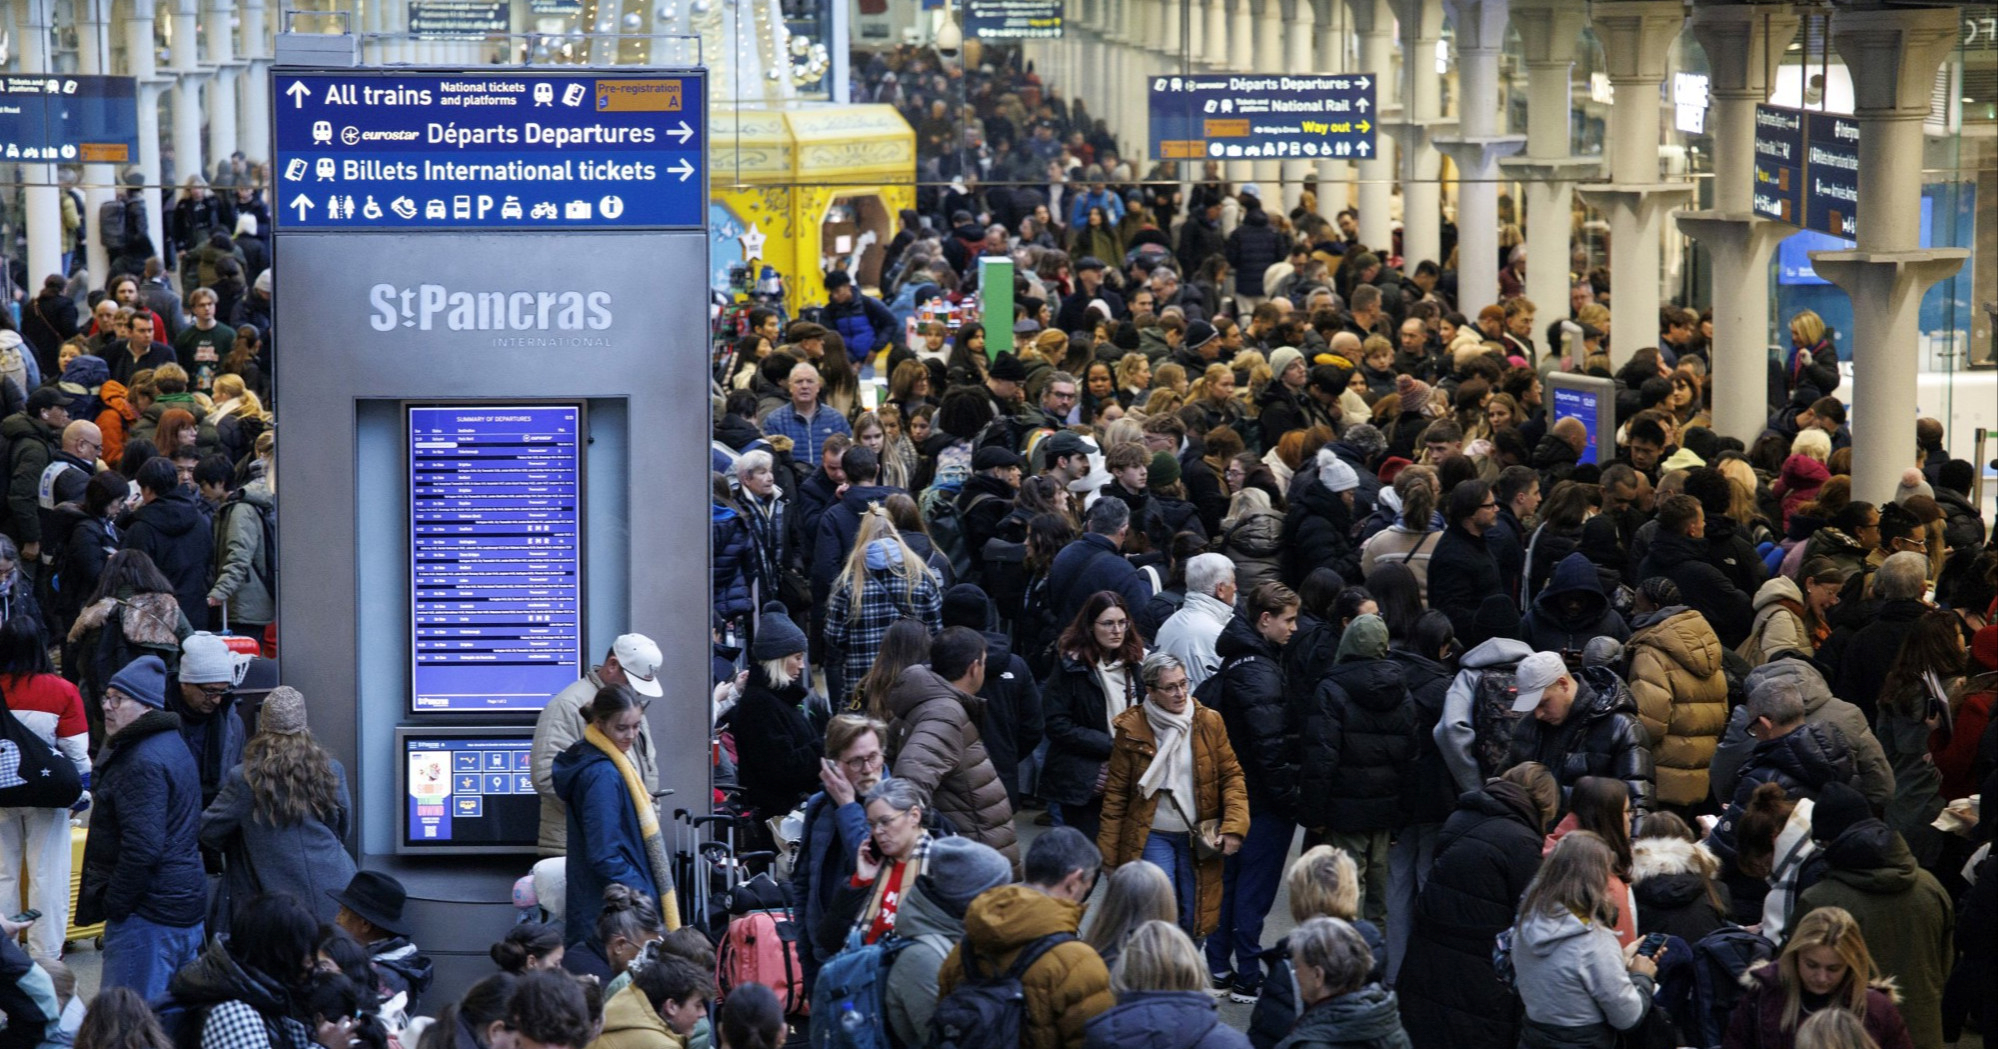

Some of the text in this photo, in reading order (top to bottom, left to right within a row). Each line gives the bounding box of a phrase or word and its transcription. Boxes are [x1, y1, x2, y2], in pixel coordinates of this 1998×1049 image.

[440, 82, 526, 92] National tickets
[598, 83, 680, 95] Pre-registration
[1229, 78, 1278, 92] Départs
[1280, 78, 1350, 92] Departures
[325, 84, 432, 105] All trains
[440, 95, 517, 107] and platforms
[668, 95, 679, 108] A
[1271, 100, 1350, 112] National Rail
[361, 121, 656, 148] eurostar Départs Departures
[1302, 121, 1351, 135] Way out
[343, 158, 656, 181] Billets International tickets
[492, 337, 612, 347] INTERNATIONAL
